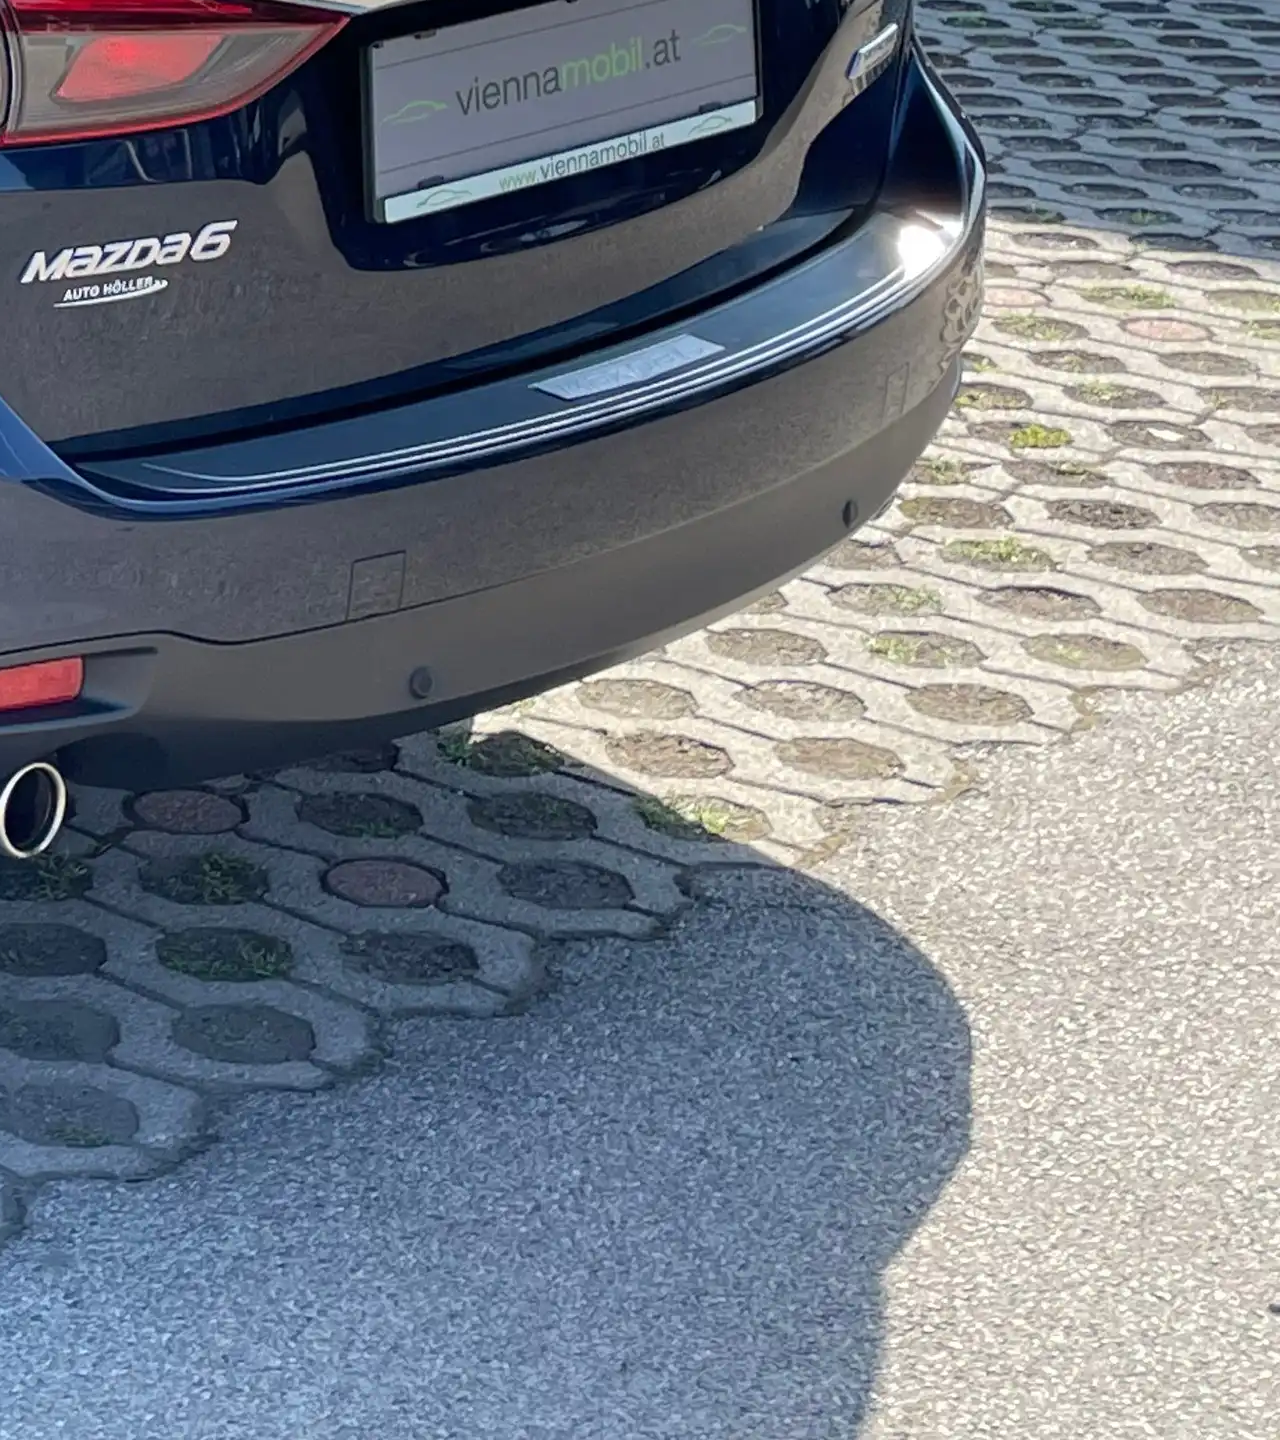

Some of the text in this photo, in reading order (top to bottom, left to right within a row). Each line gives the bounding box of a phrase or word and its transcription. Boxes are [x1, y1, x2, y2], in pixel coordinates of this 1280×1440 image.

[455, 29, 682, 116] viennamobil.at
[498, 129, 666, 192] www.viennamobil.at
[63, 285, 101, 302] AUTO
